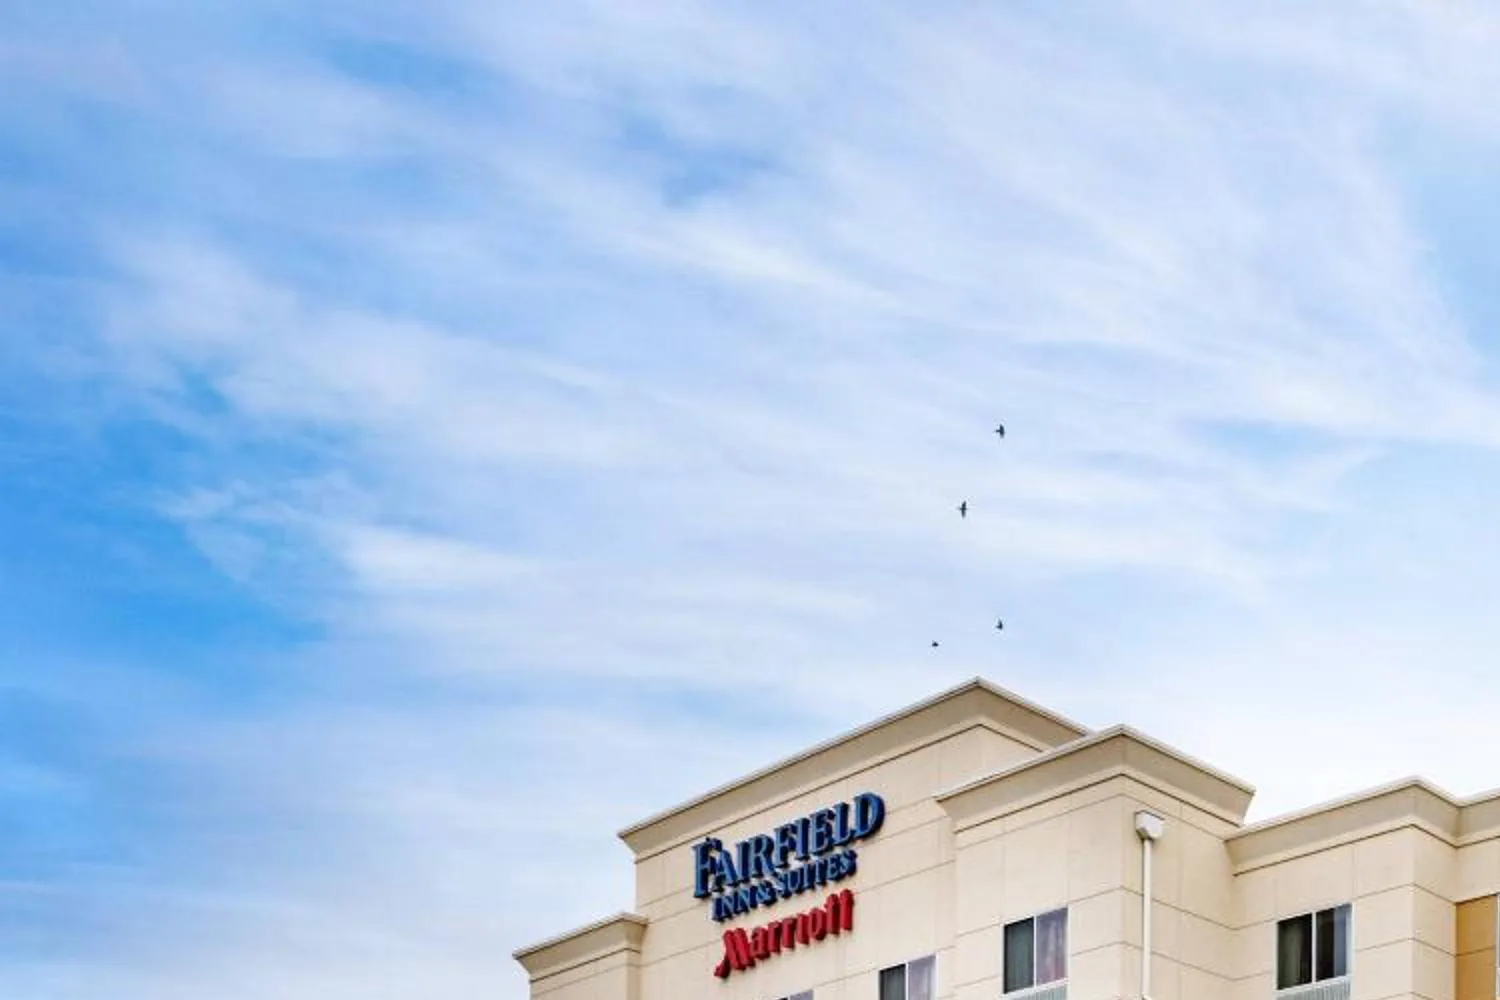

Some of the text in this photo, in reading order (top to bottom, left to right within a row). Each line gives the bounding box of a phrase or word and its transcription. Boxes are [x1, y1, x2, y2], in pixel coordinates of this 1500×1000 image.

[692, 792, 885, 898] FAIRFIELD
[711, 850, 858, 922] INN & SUITES
[714, 888, 854, 979] Marriott
